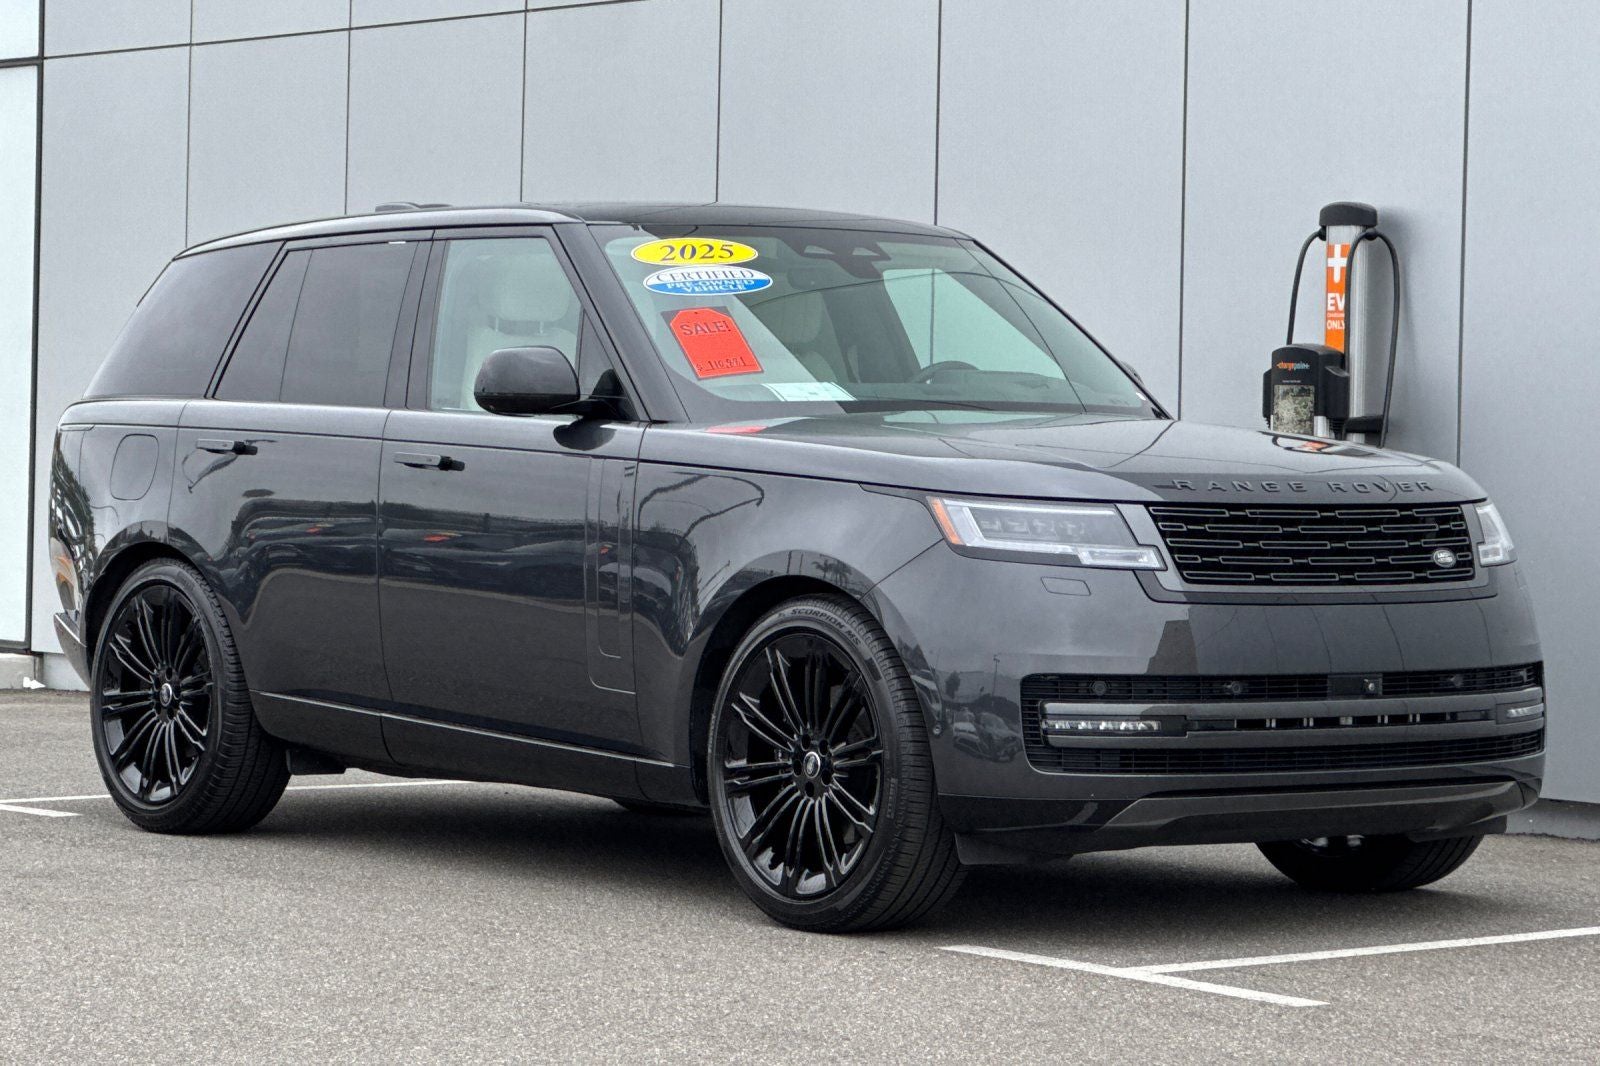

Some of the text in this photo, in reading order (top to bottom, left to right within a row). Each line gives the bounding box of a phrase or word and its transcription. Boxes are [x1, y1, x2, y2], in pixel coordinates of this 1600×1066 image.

[660, 243, 734, 262] 2025
[656, 269, 755, 282] CERTIFIED
[666, 279, 755, 289] PRE-OWNED
[683, 284, 747, 293] VEHICLE
[1327, 292, 1345, 311] EV
[680, 320, 732, 336] SALE!
[1172, 478, 1435, 494] RANGE ROVER
[790, 608, 845, 629] SCORPION
